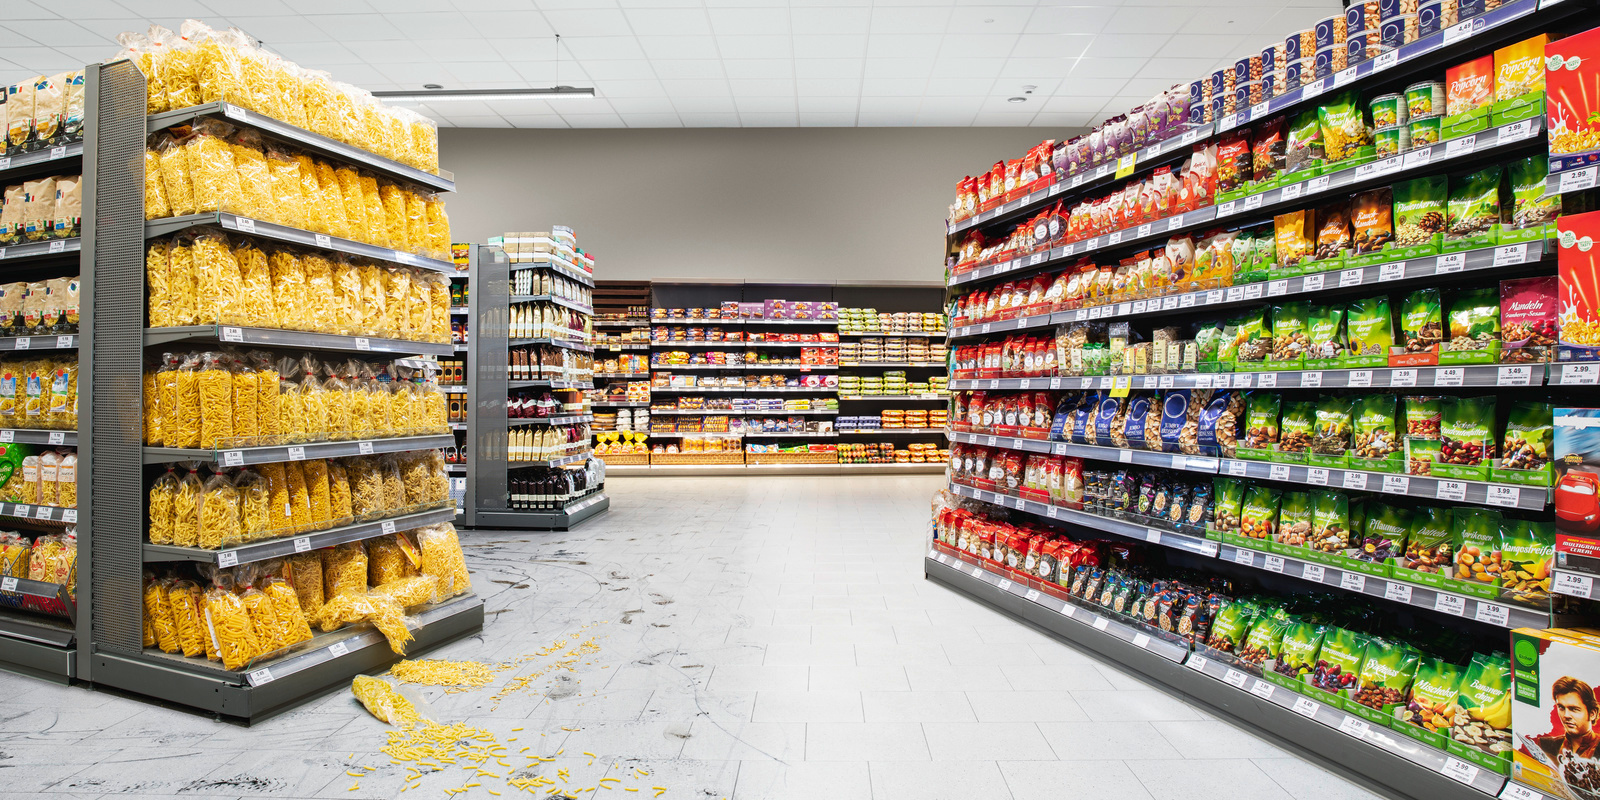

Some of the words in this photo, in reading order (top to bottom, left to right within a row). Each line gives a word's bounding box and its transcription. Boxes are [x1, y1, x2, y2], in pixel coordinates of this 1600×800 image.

[1501, 56, 1541, 78] Popcorn
[1451, 75, 1487, 96] Popcorn
[1508, 124, 1522, 132] 2.99
[1572, 171, 1586, 179] 2.99
[1397, 200, 1443, 213] Pinienkerne
[1355, 218, 1378, 228] Mandeln
[1508, 300, 1544, 312] Mandeln
[1505, 310, 1546, 319] Cranberry-Sesam
[1276, 319, 1302, 328] Nuss-Mix
[1312, 323, 1334, 332] Cashew-
[1440, 426, 1488, 436] Studentenfutter
[1369, 518, 1406, 533] Pflaumen
[1417, 527, 1448, 538] Datteln
[1414, 680, 1458, 698] Mischobst
[1470, 679, 1504, 696] Bananen-
[1475, 692, 1494, 703] chips
[1456, 762, 1468, 771] 2.99
[1516, 788, 1530, 798] 2.99
